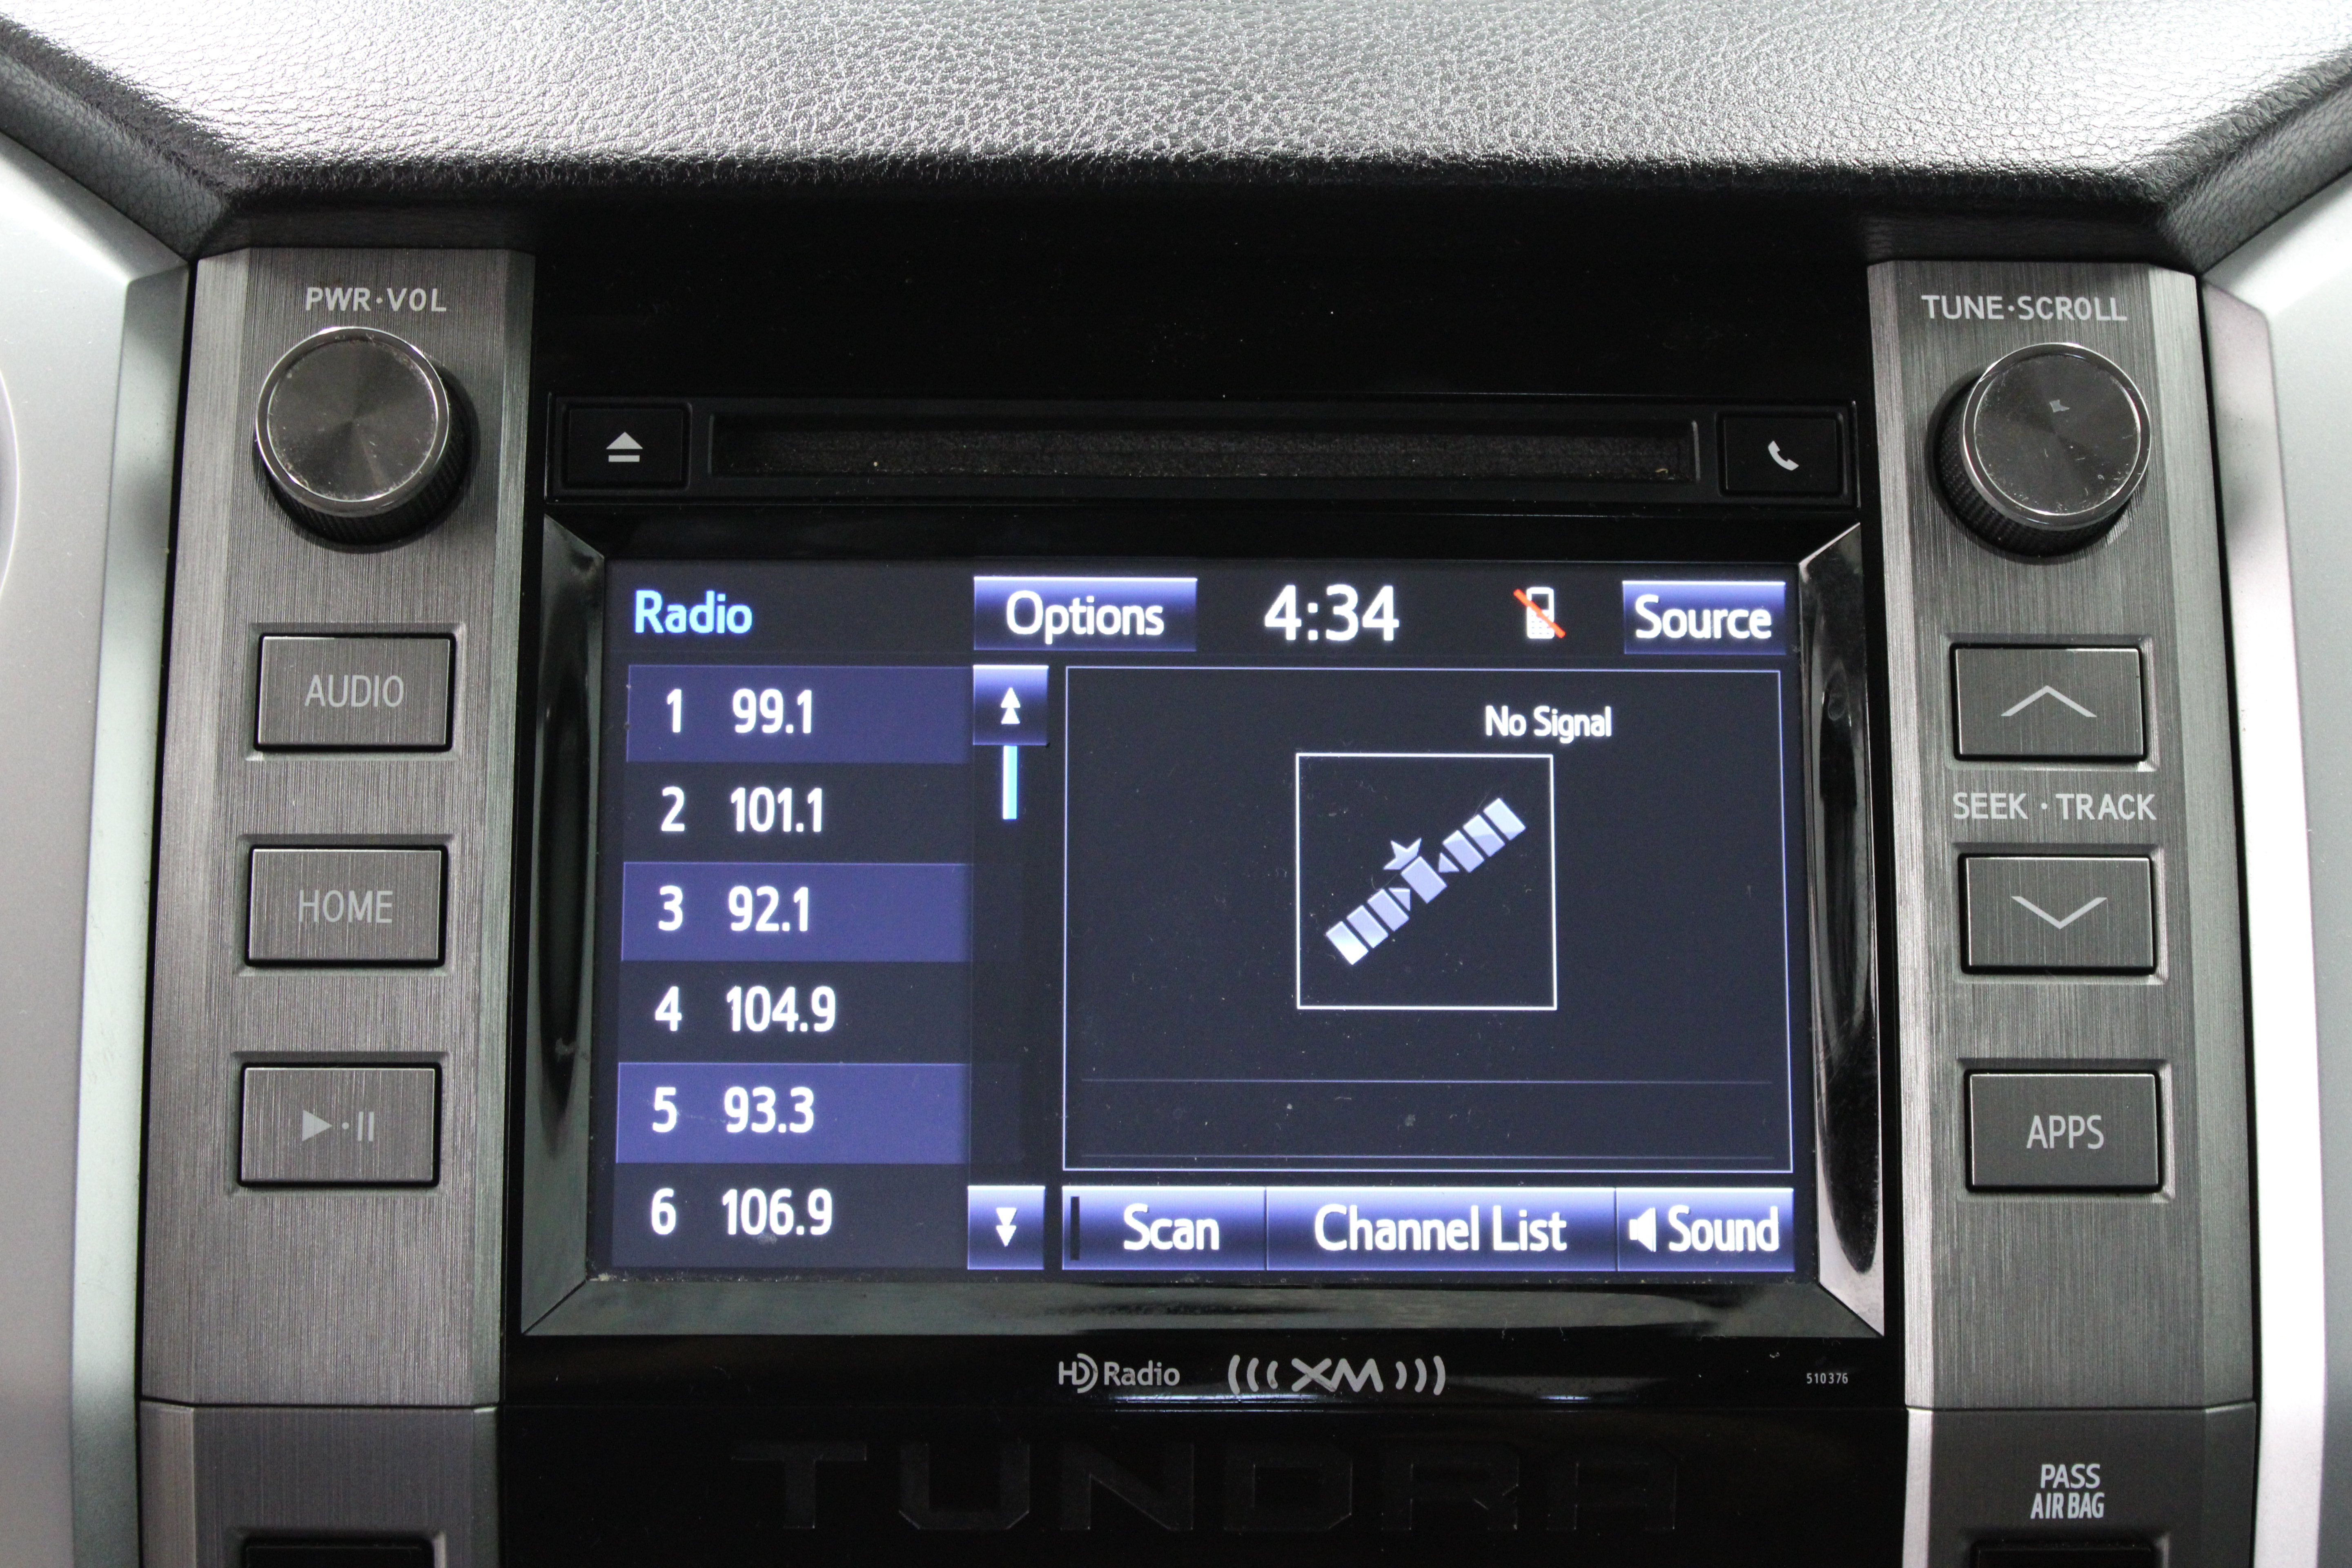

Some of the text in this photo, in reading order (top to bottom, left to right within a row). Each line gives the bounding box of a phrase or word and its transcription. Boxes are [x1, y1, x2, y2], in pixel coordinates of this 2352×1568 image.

[635, 590, 753, 634] Radio
[1006, 590, 1165, 645] Options
[1264, 584, 1400, 641] 4:34
[1635, 593, 1773, 639] Source
[305, 675, 405, 707] AUDIO
[666, 688, 813, 734] 1 99.1
[1485, 705, 1612, 744] No Signal
[661, 786, 822, 833] 2 101.1
[1953, 792, 2029, 819] SEEK
[298, 890, 393, 923] HOME
[658, 885, 809, 932] 3 92.1
[655, 985, 836, 1032] 4 104.9
[652, 1086, 814, 1134] 5 93.3
[2026, 1115, 2105, 1150] APPS
[651, 1188, 833, 1236] 6 106.9
[1123, 1203, 1221, 1251] Scan
[1313, 1204, 1568, 1252] Channel List
[1668, 1205, 1780, 1253] Sound
[1104, 1360, 1180, 1386] Radio
[1806, 1372, 1849, 1384] 510376
[731, 1441, 1678, 1531] TUNDRA
[2040, 1463, 2101, 1489] PASS
[2030, 1492, 2105, 1519] AIR BAG
